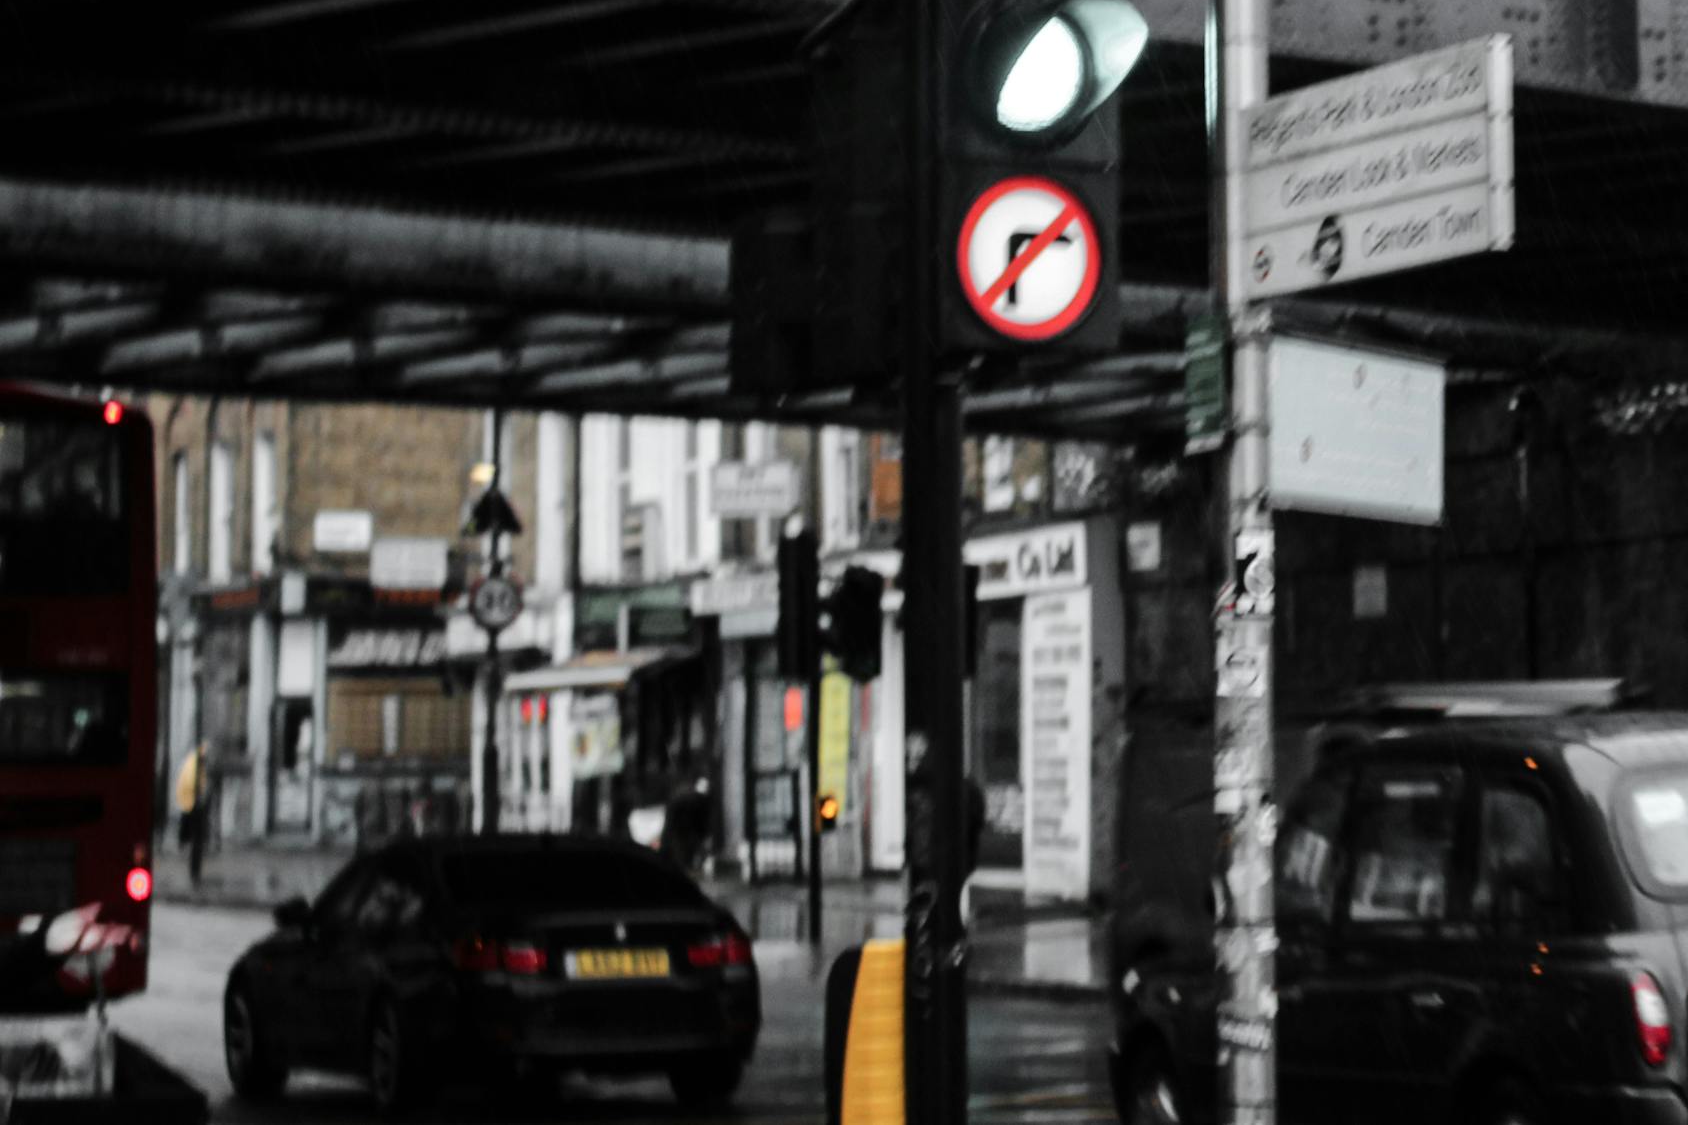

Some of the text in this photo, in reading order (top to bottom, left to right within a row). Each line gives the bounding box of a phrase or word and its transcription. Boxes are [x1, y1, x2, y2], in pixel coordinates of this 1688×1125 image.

[1281, 167, 1349, 207] Camden
[1362, 203, 1481, 257] Camden Town
